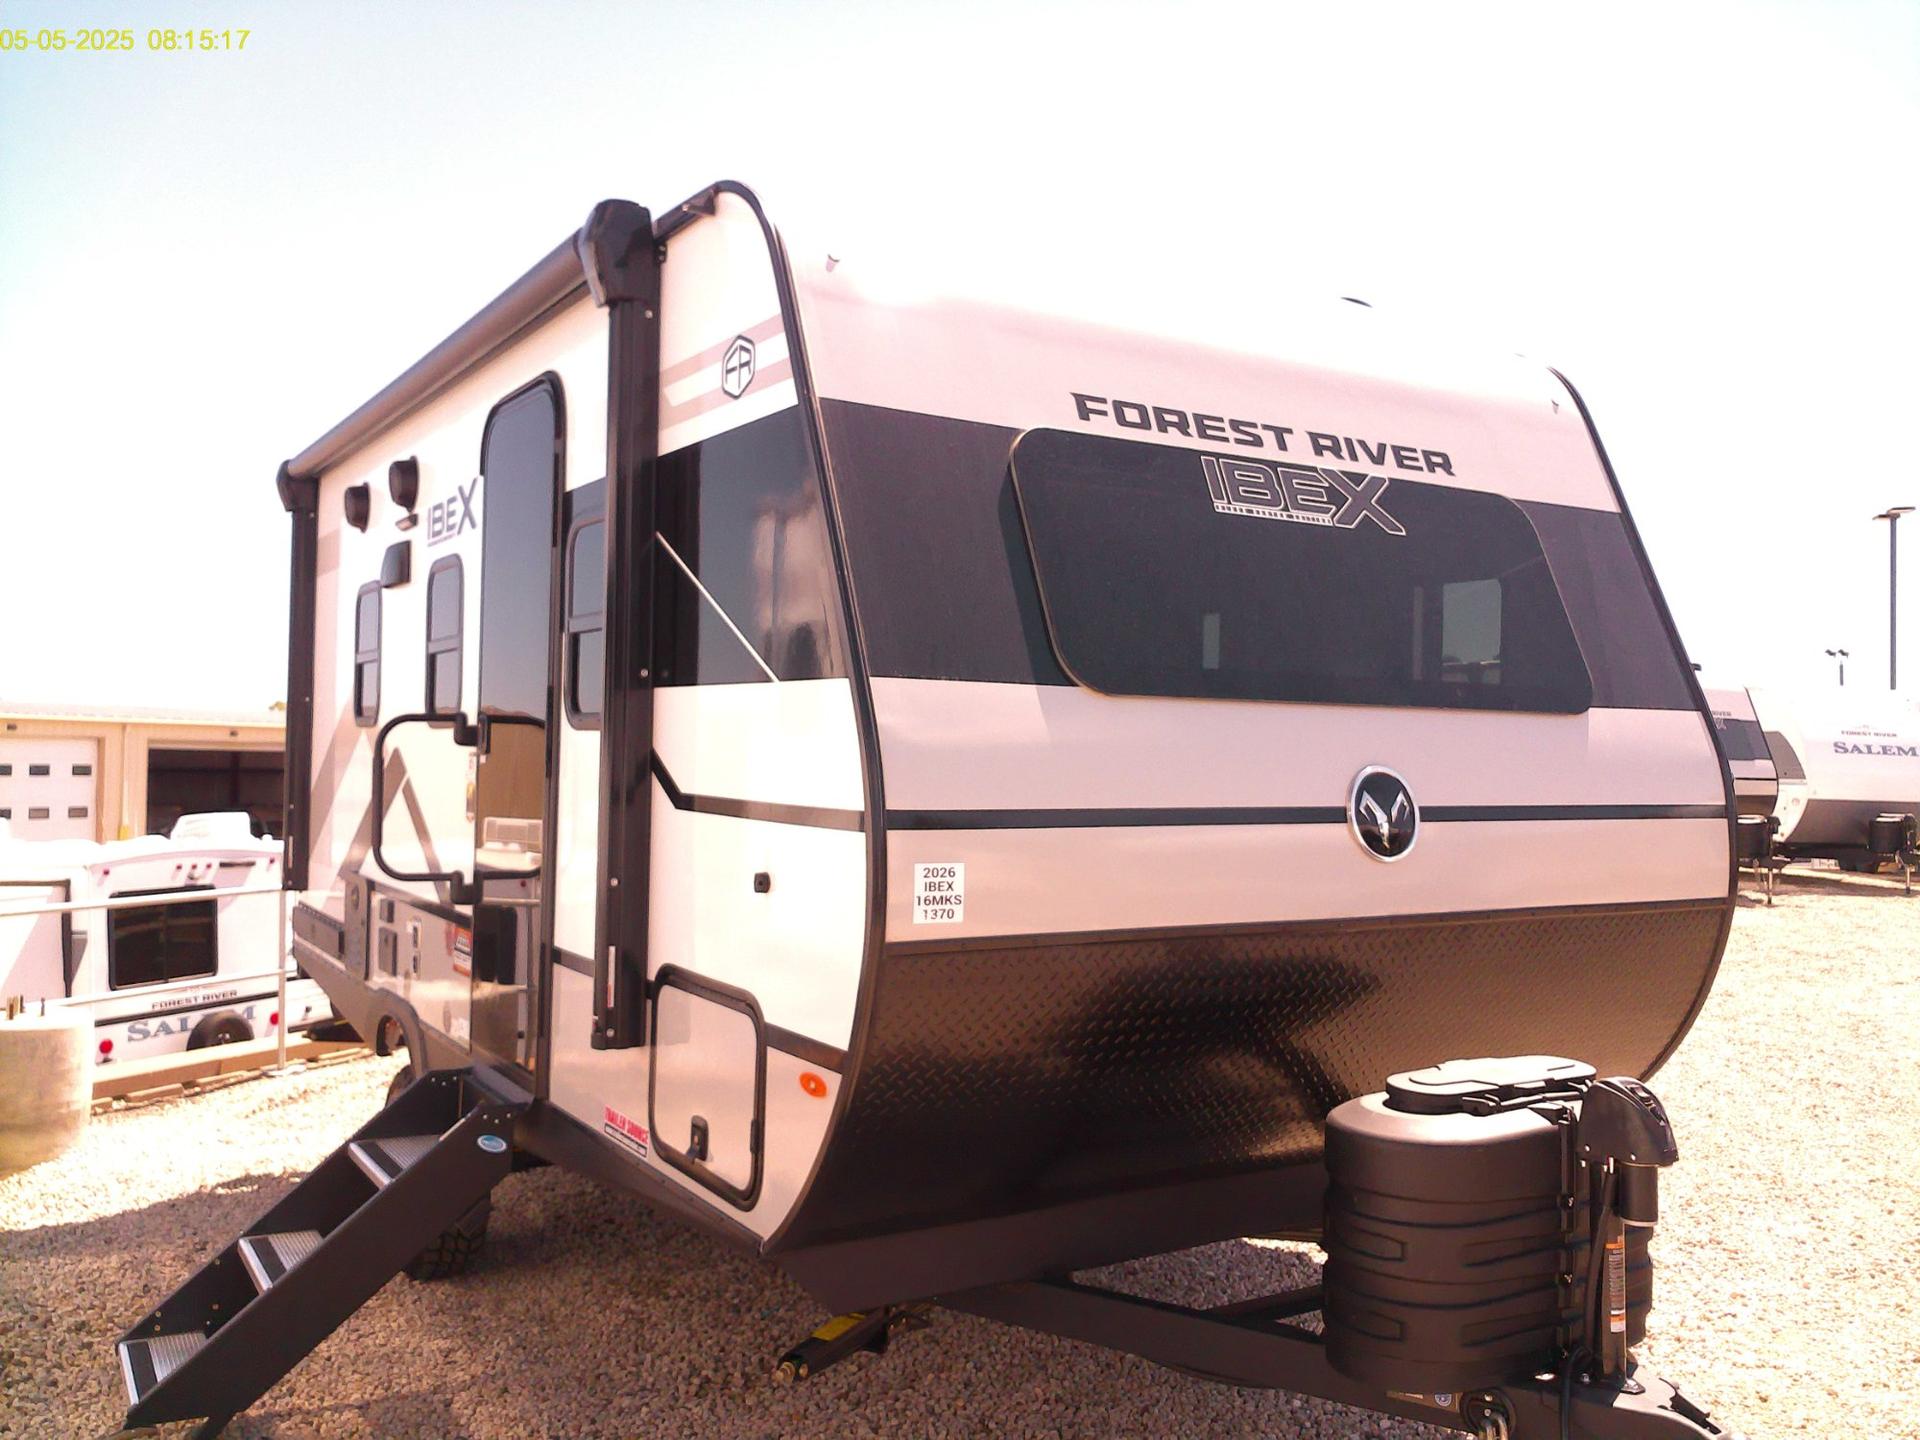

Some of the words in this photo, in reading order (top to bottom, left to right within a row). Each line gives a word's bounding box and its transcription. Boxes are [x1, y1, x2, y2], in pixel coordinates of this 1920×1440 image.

[1070, 392, 1294, 452] FOREST
[1306, 431, 1456, 477] RIVER
[1200, 455, 1407, 536] IBEX
[427, 476, 478, 540] IBEX
[1833, 741, 1919, 757] SALEM
[923, 866, 956, 879] 2026
[924, 880, 954, 892] IBEX
[916, 894, 962, 906] 16MKS
[923, 908, 955, 920] 1370
[152, 996, 200, 1009] FOREST
[202, 989, 238, 1001] RIVER
